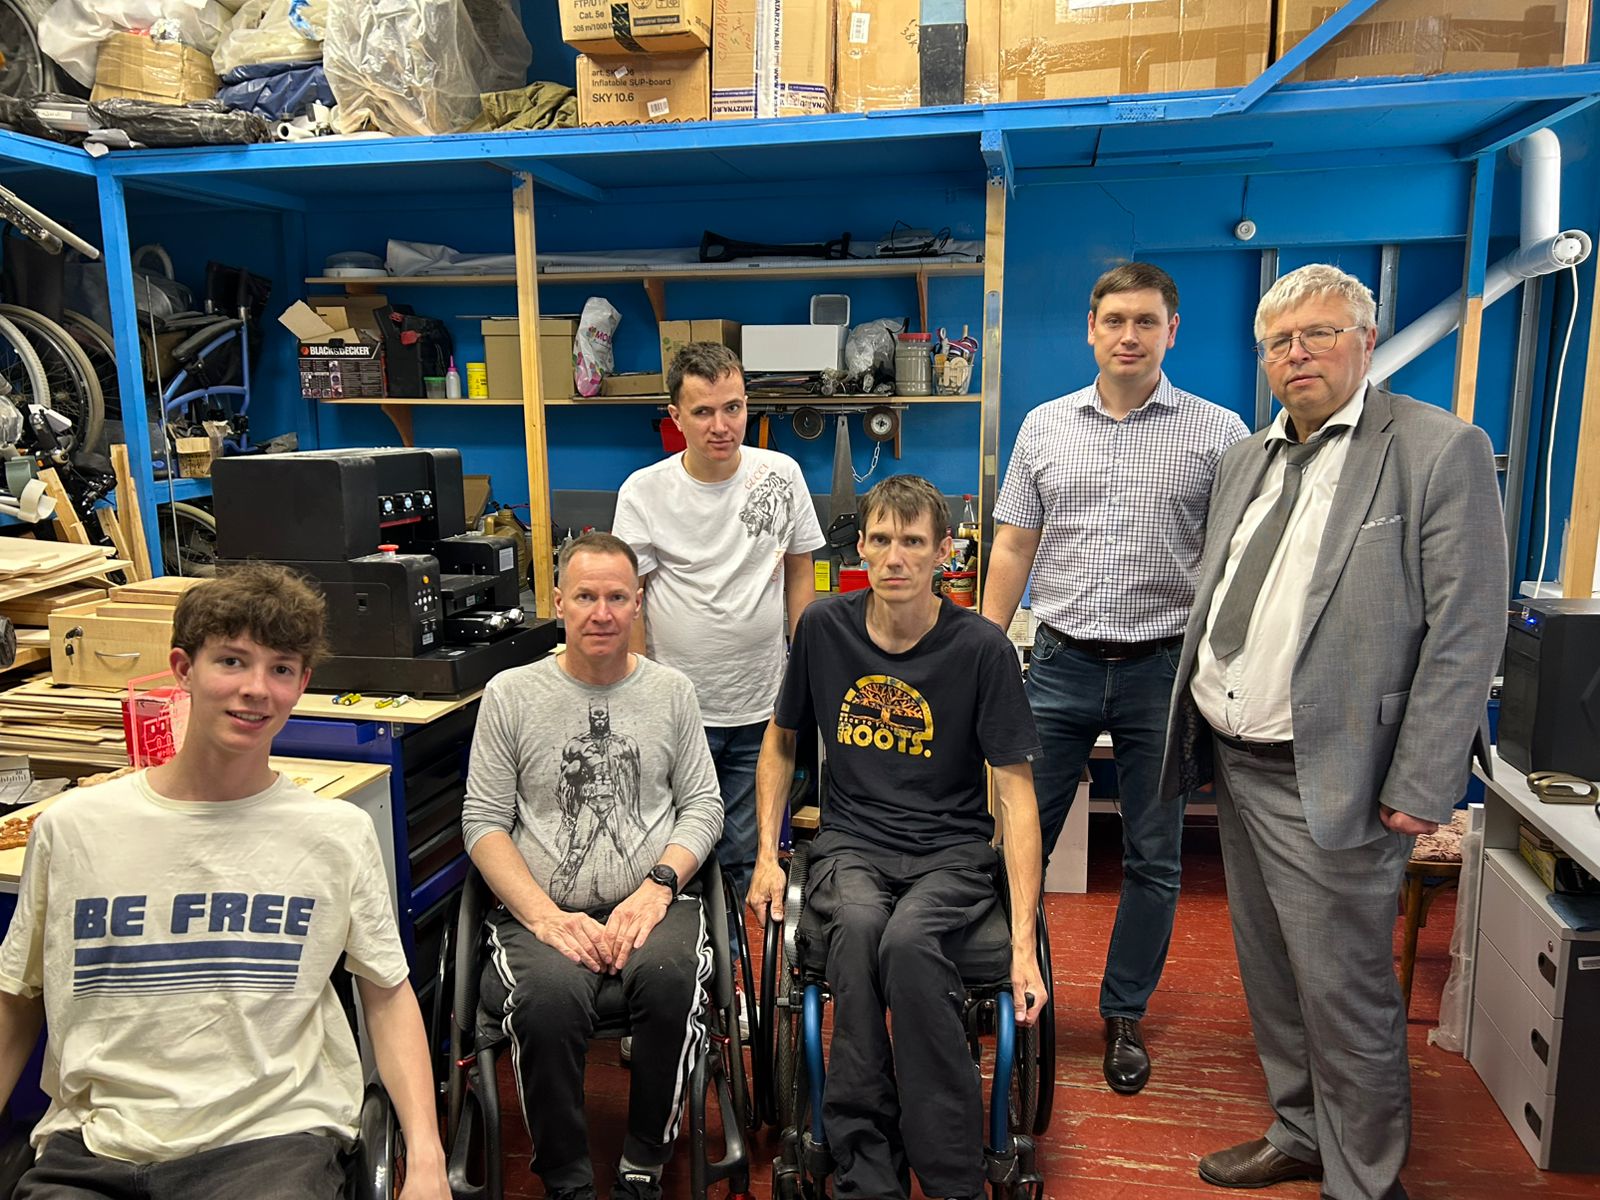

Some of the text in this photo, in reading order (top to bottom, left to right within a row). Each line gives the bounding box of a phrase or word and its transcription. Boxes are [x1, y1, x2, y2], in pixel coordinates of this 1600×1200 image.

[579, 11, 594, 19] Cat.
[592, 78, 672, 87] Inflatable SUP-board
[592, 92, 635, 102] SKY 10.6
[74, 892, 316, 940] BE FREE
